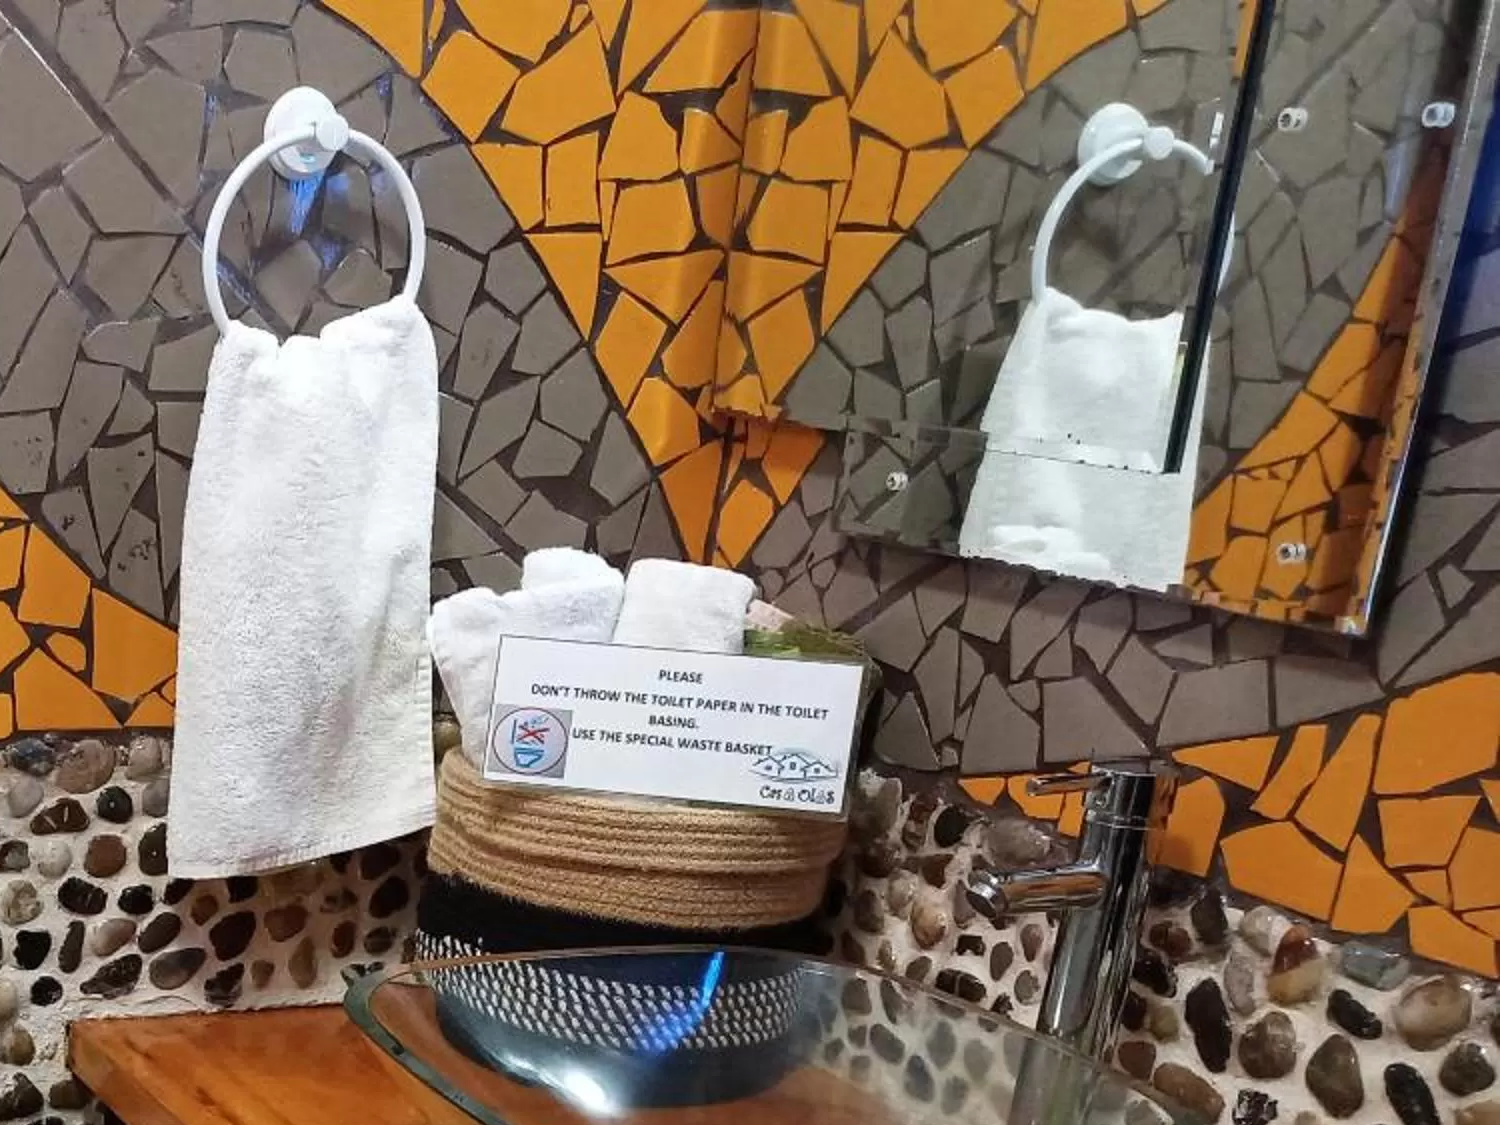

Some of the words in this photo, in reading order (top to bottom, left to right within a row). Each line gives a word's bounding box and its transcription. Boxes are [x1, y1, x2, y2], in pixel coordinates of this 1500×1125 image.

[658, 669, 704, 684] PLEASE
[531, 683, 571, 697] DON'T
[574, 687, 621, 702] THROW
[624, 691, 648, 704] THE
[651, 694, 694, 708] TOILET
[695, 698, 737, 712] PAPER
[740, 701, 754, 714] IN
[758, 703, 782, 717] THE
[786, 705, 830, 720] TOILET
[648, 715, 700, 729] BASING.
[572, 727, 596, 740] USE
[599, 730, 623, 743] THE
[625, 732, 674, 747] SPECIAL
[677, 737, 722, 751] WASTE
[725, 741, 773, 756] BASKET
